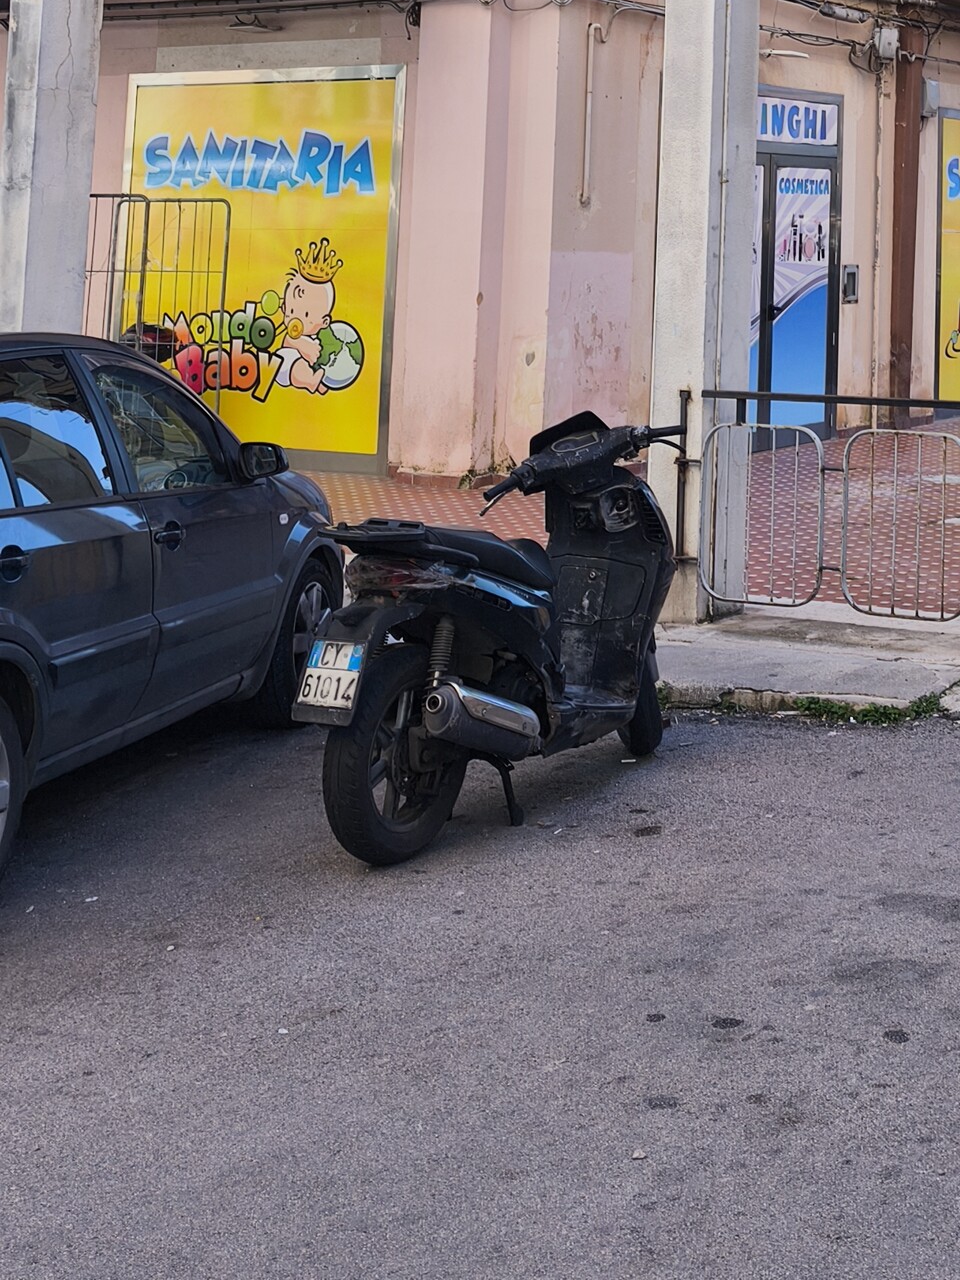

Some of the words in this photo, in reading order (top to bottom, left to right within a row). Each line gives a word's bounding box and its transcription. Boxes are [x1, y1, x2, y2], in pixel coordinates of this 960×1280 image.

[759, 103, 827, 140] INGHI
[144, 129, 376, 196] SANITARIA
[778, 177, 830, 195] COSMETICA
[162, 301, 276, 350] Mondo
[173, 336, 284, 403] Baby
[320, 642, 344, 667] CY
[301, 673, 356, 702] 61014
